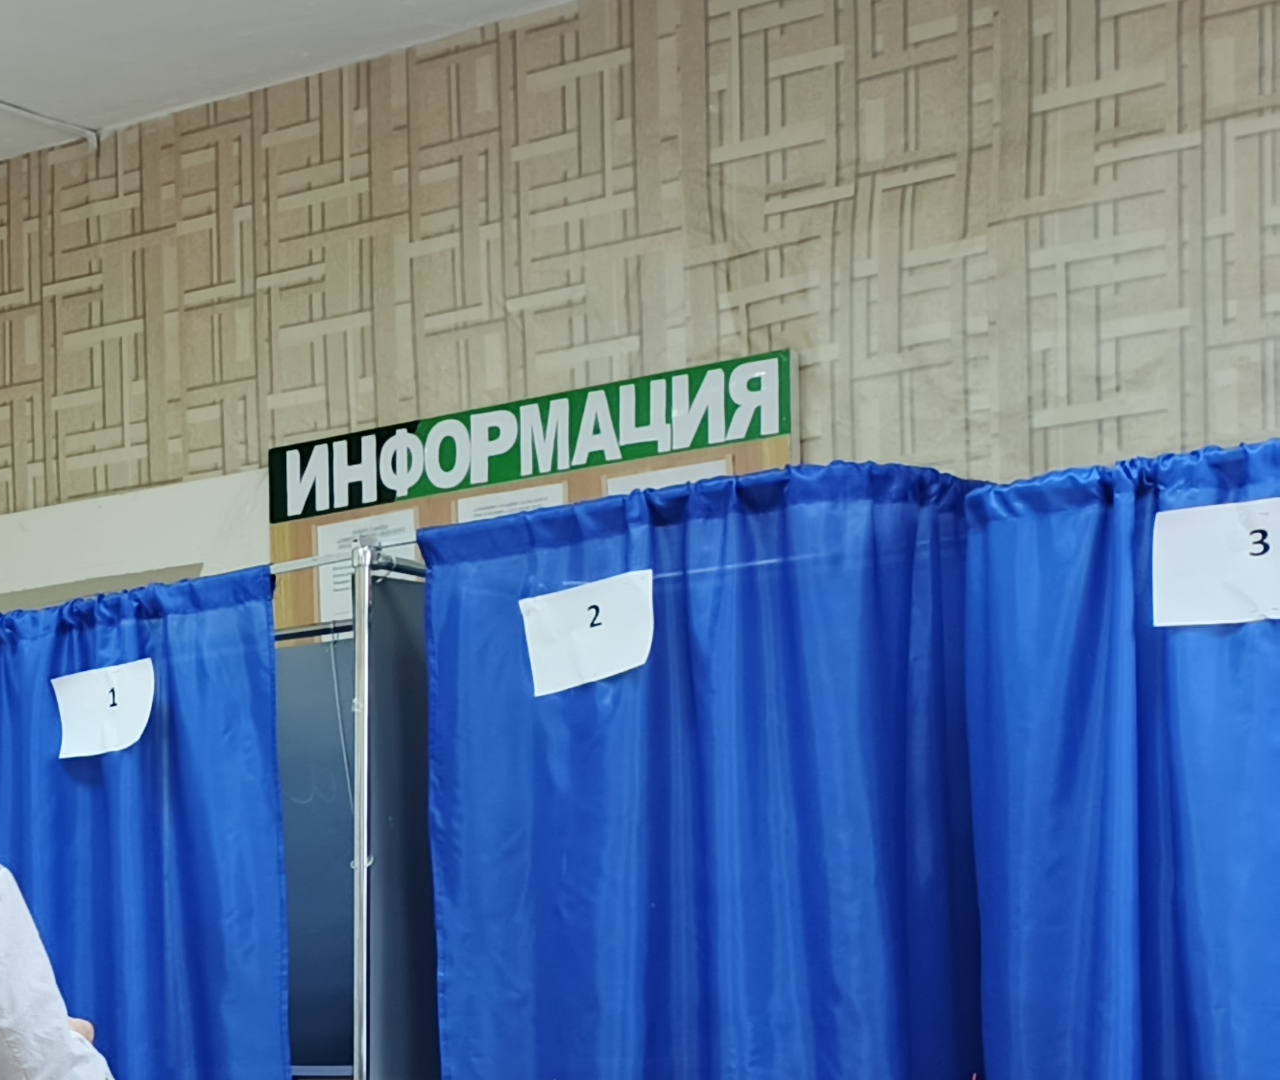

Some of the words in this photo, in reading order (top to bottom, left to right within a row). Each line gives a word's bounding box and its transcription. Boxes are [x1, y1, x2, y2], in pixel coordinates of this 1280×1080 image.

[285, 357, 780, 517] ИНФОРМАЦИЯ
[1248, 529, 1271, 557] 3
[587, 604, 603, 628] 2
[108, 687, 118, 708] 1
